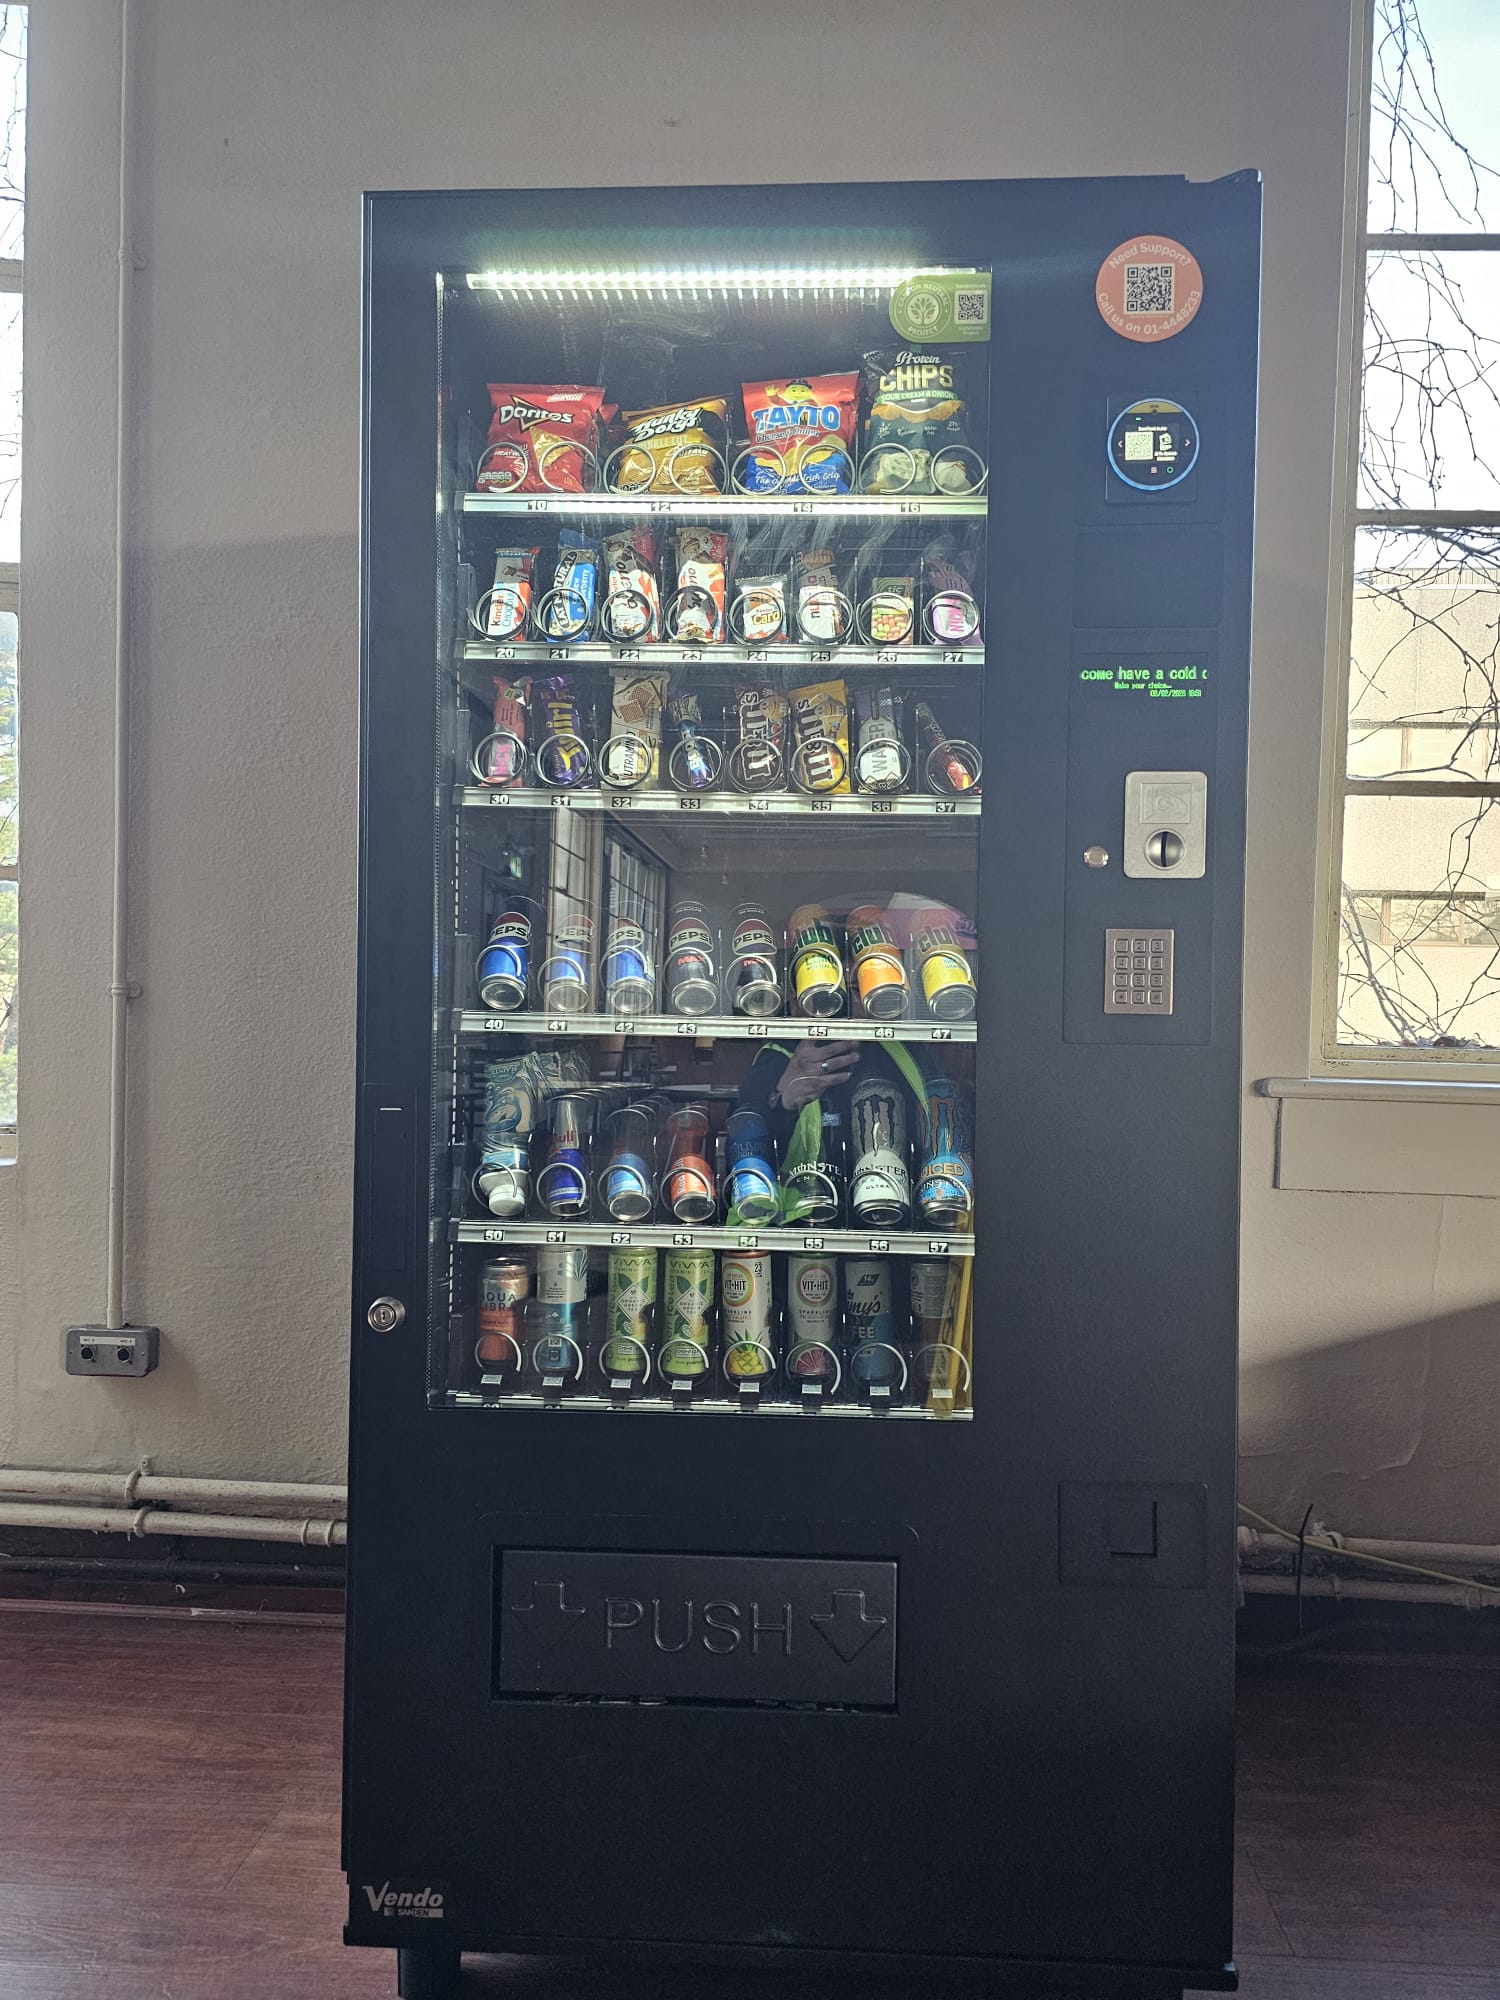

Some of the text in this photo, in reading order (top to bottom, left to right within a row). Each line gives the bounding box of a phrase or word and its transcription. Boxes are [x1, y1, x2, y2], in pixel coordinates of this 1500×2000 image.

[1109, 243, 1191, 268] Need Support?
[898, 283, 922, 307] CAON
[1099, 290, 1200, 334] Call us on 01-4448233
[907, 326, 938, 337] PROJECT
[895, 351, 941, 367] Protein
[879, 364, 953, 392] CHIPS
[881, 394, 900, 402] SOUR
[901, 392, 925, 400] CREAM
[931, 390, 954, 398] ONION
[500, 404, 574, 425] Doritos
[630, 407, 702, 432] Hunky
[752, 405, 841, 433] TAYTO
[634, 417, 698, 442] Dorys
[757, 431, 784, 442] Cheese
[530, 501, 548, 511] 10
[653, 503, 671, 512] 12
[795, 503, 812, 513] 14
[903, 504, 920, 513] 16
[887, 585, 903, 593] tic
[491, 595, 505, 626] kinder
[502, 584, 516, 627] CHOCOLAE
[557, 605, 569, 626] EAT
[751, 610, 780, 626] Card
[496, 648, 515, 658] 20
[551, 649, 568, 659] 21
[620, 650, 639, 660] 22
[748, 651, 767, 661] 24
[944, 653, 962, 662] 27
[1081, 669, 1114, 680] come
[1118, 666, 1150, 680] have
[1155, 669, 1164, 680] a
[1169, 666, 1197, 680] cold
[546, 701, 581, 771] Twirl
[491, 795, 509, 804] 30
[552, 796, 570, 806] 31
[612, 798, 631, 808] 32
[682, 799, 700, 809] 33
[749, 801, 768, 810] 34
[813, 802, 831, 811] 35
[872, 802, 891, 812] 36
[936, 803, 955, 812] 37
[607, 929, 642, 943] EPSI
[670, 931, 713, 947] PEPSI
[485, 1019, 504, 1030] 40
[549, 1021, 566, 1031] 41
[615, 1022, 634, 1032] 42
[678, 1024, 696, 1034] 43
[749, 1026, 767, 1035] 44
[809, 1027, 827, 1036] 45
[875, 1028, 893, 1038] 46
[932, 1029, 950, 1039] 47
[789, 1160, 842, 1177] MONSTE
[921, 1162, 965, 1178] UICED
[485, 1230, 503, 1241] 50
[548, 1232, 565, 1242] 51
[612, 1233, 630, 1243] 52
[674, 1235, 692, 1245] 53
[739, 1237, 757, 1247] 54
[805, 1238, 823, 1248] 55
[870, 1241, 888, 1251] 56
[930, 1243, 948, 1253] 57
[754, 1262, 763, 1273] 23
[483, 1291, 517, 1302] QUA
[605, 1597, 793, 1656] PUSH
[362, 1880, 444, 1912] Vendo
